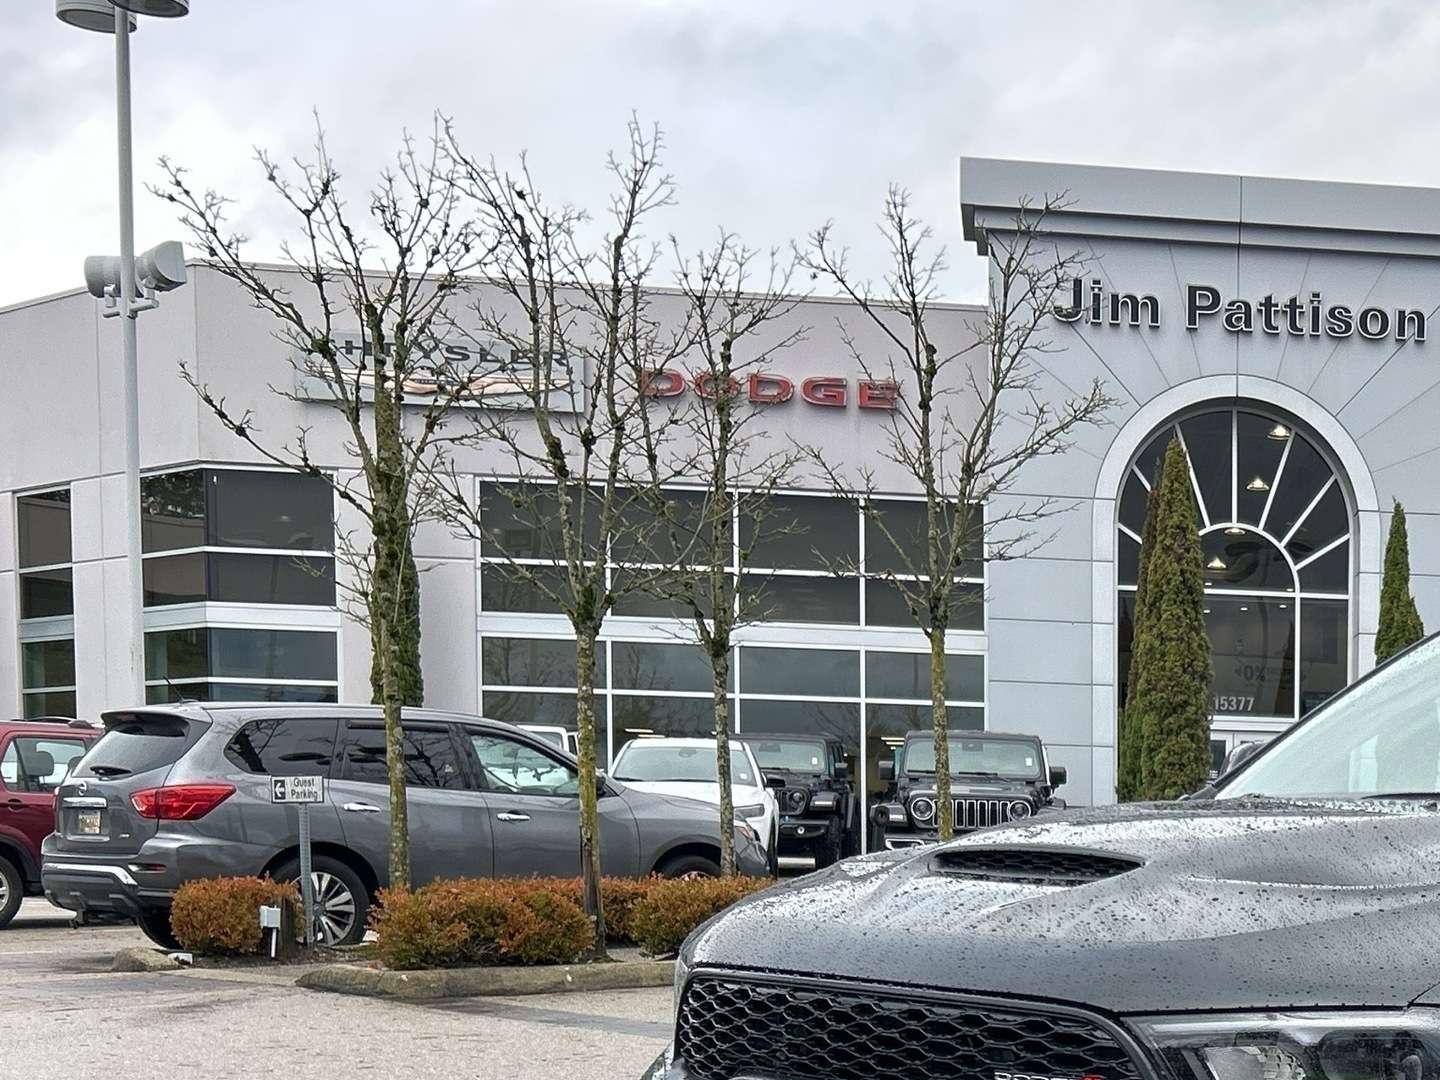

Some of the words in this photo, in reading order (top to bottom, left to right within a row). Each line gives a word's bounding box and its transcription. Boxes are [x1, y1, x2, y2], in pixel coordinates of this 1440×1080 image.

[1053, 278, 1161, 328] Jim
[1186, 283, 1428, 342] Pattison
[641, 368, 900, 411] DODGE
[1213, 695, 1255, 712] 15377
[293, 777, 315, 788] Guest
[290, 789, 318, 801] Parking
